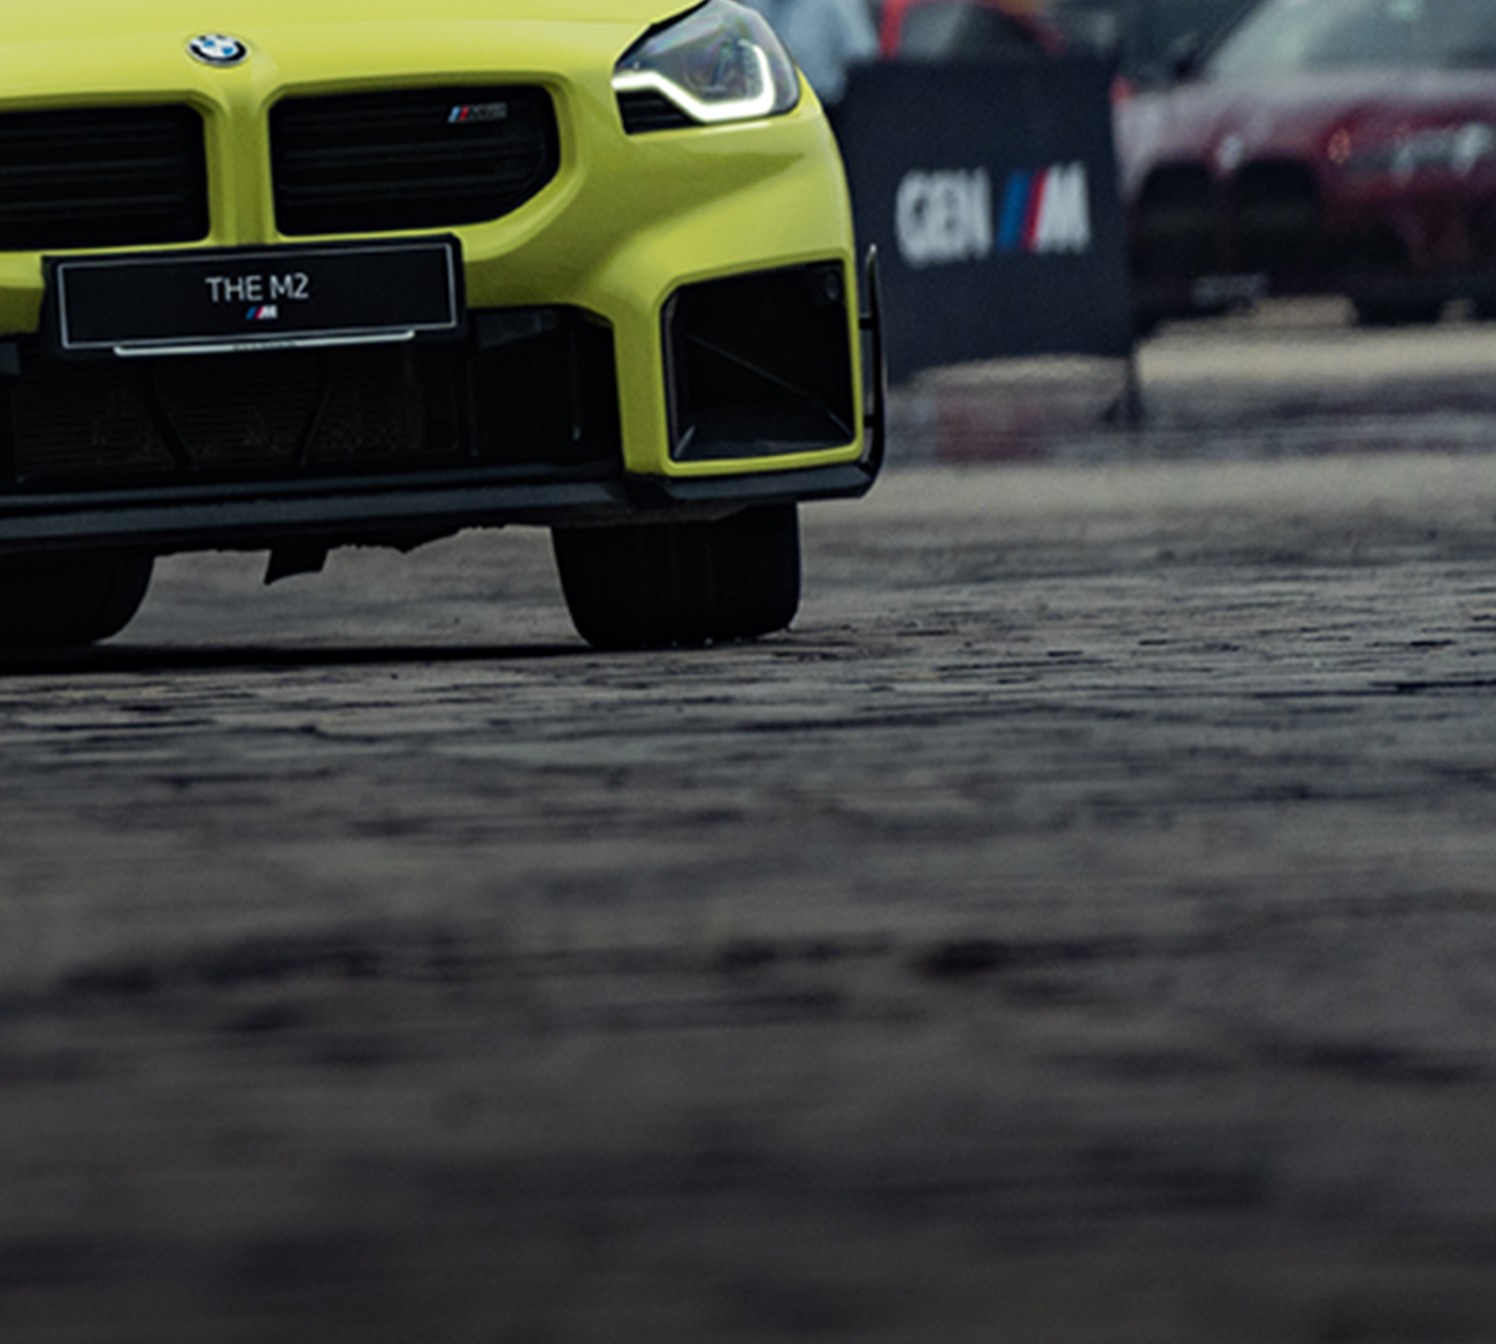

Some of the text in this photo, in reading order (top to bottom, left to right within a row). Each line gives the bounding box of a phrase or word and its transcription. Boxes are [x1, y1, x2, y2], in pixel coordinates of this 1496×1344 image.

[895, 167, 992, 266] GEN
[205, 271, 310, 303] THE M2
